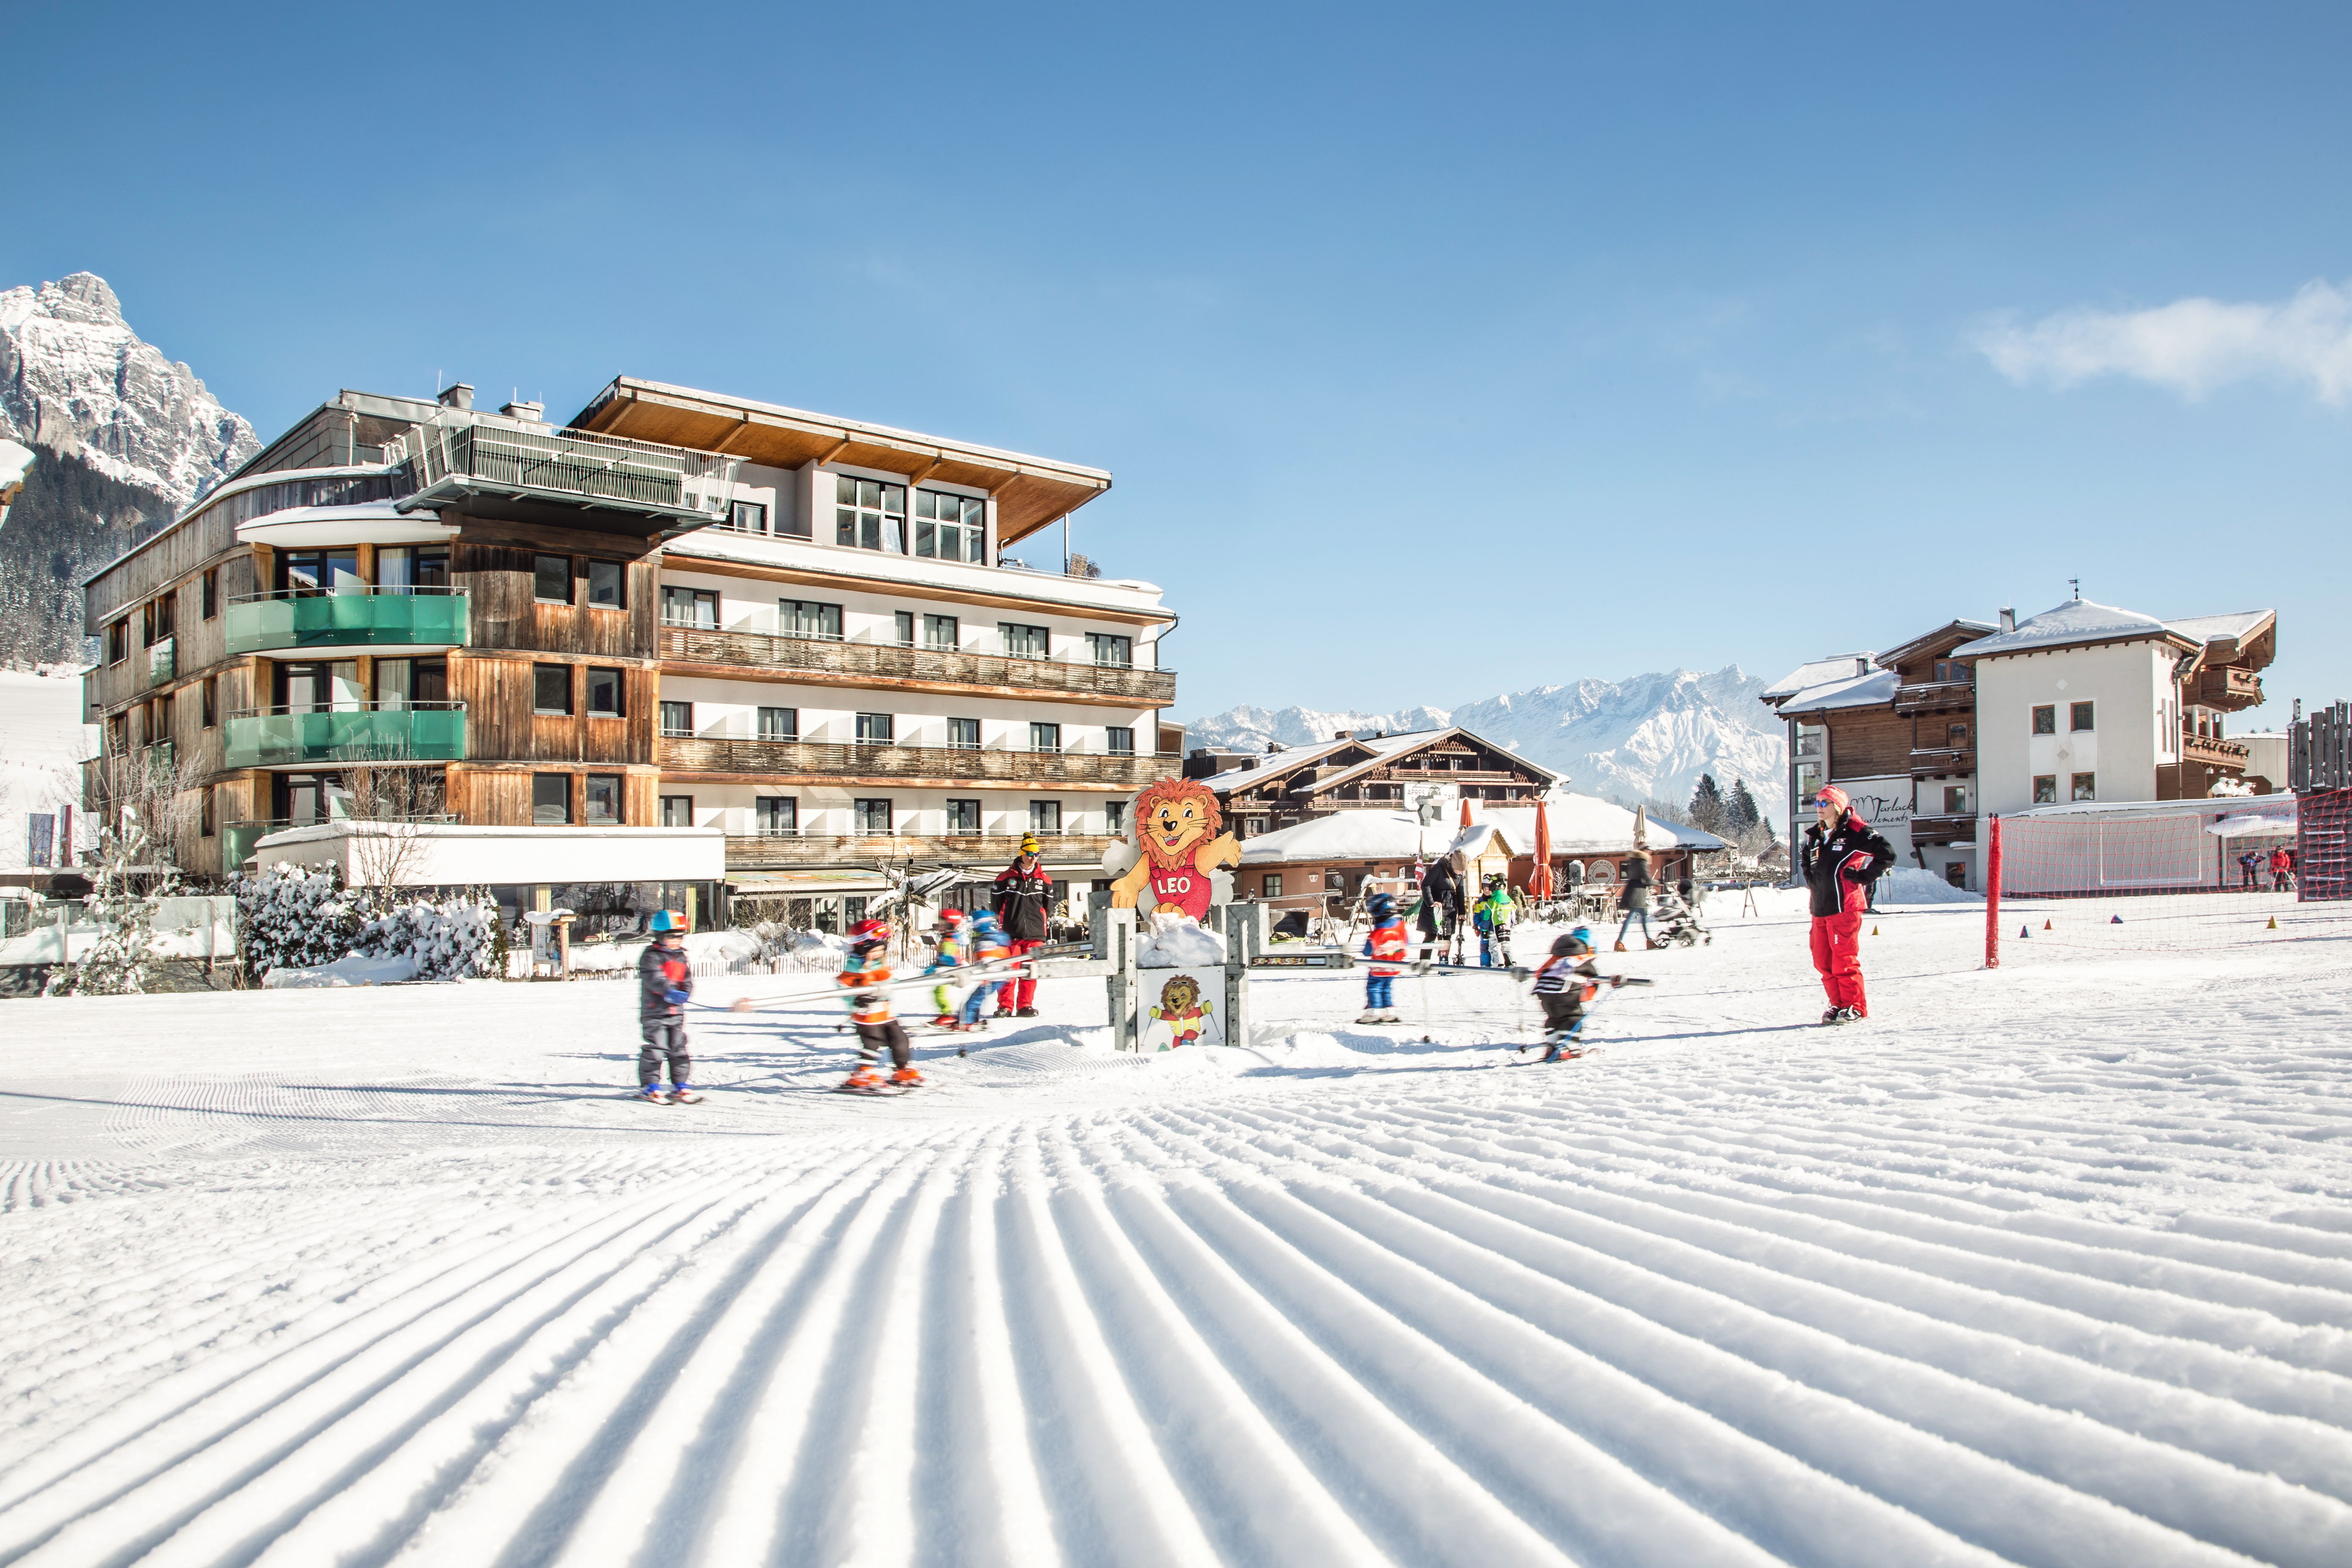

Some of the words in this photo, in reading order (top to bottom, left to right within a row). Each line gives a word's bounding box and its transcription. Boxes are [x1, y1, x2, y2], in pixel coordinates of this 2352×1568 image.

[1590, 861, 1613, 870] OUTBACK
[1157, 876, 1191, 894] LEO
[1497, 910, 1504, 921] 3
